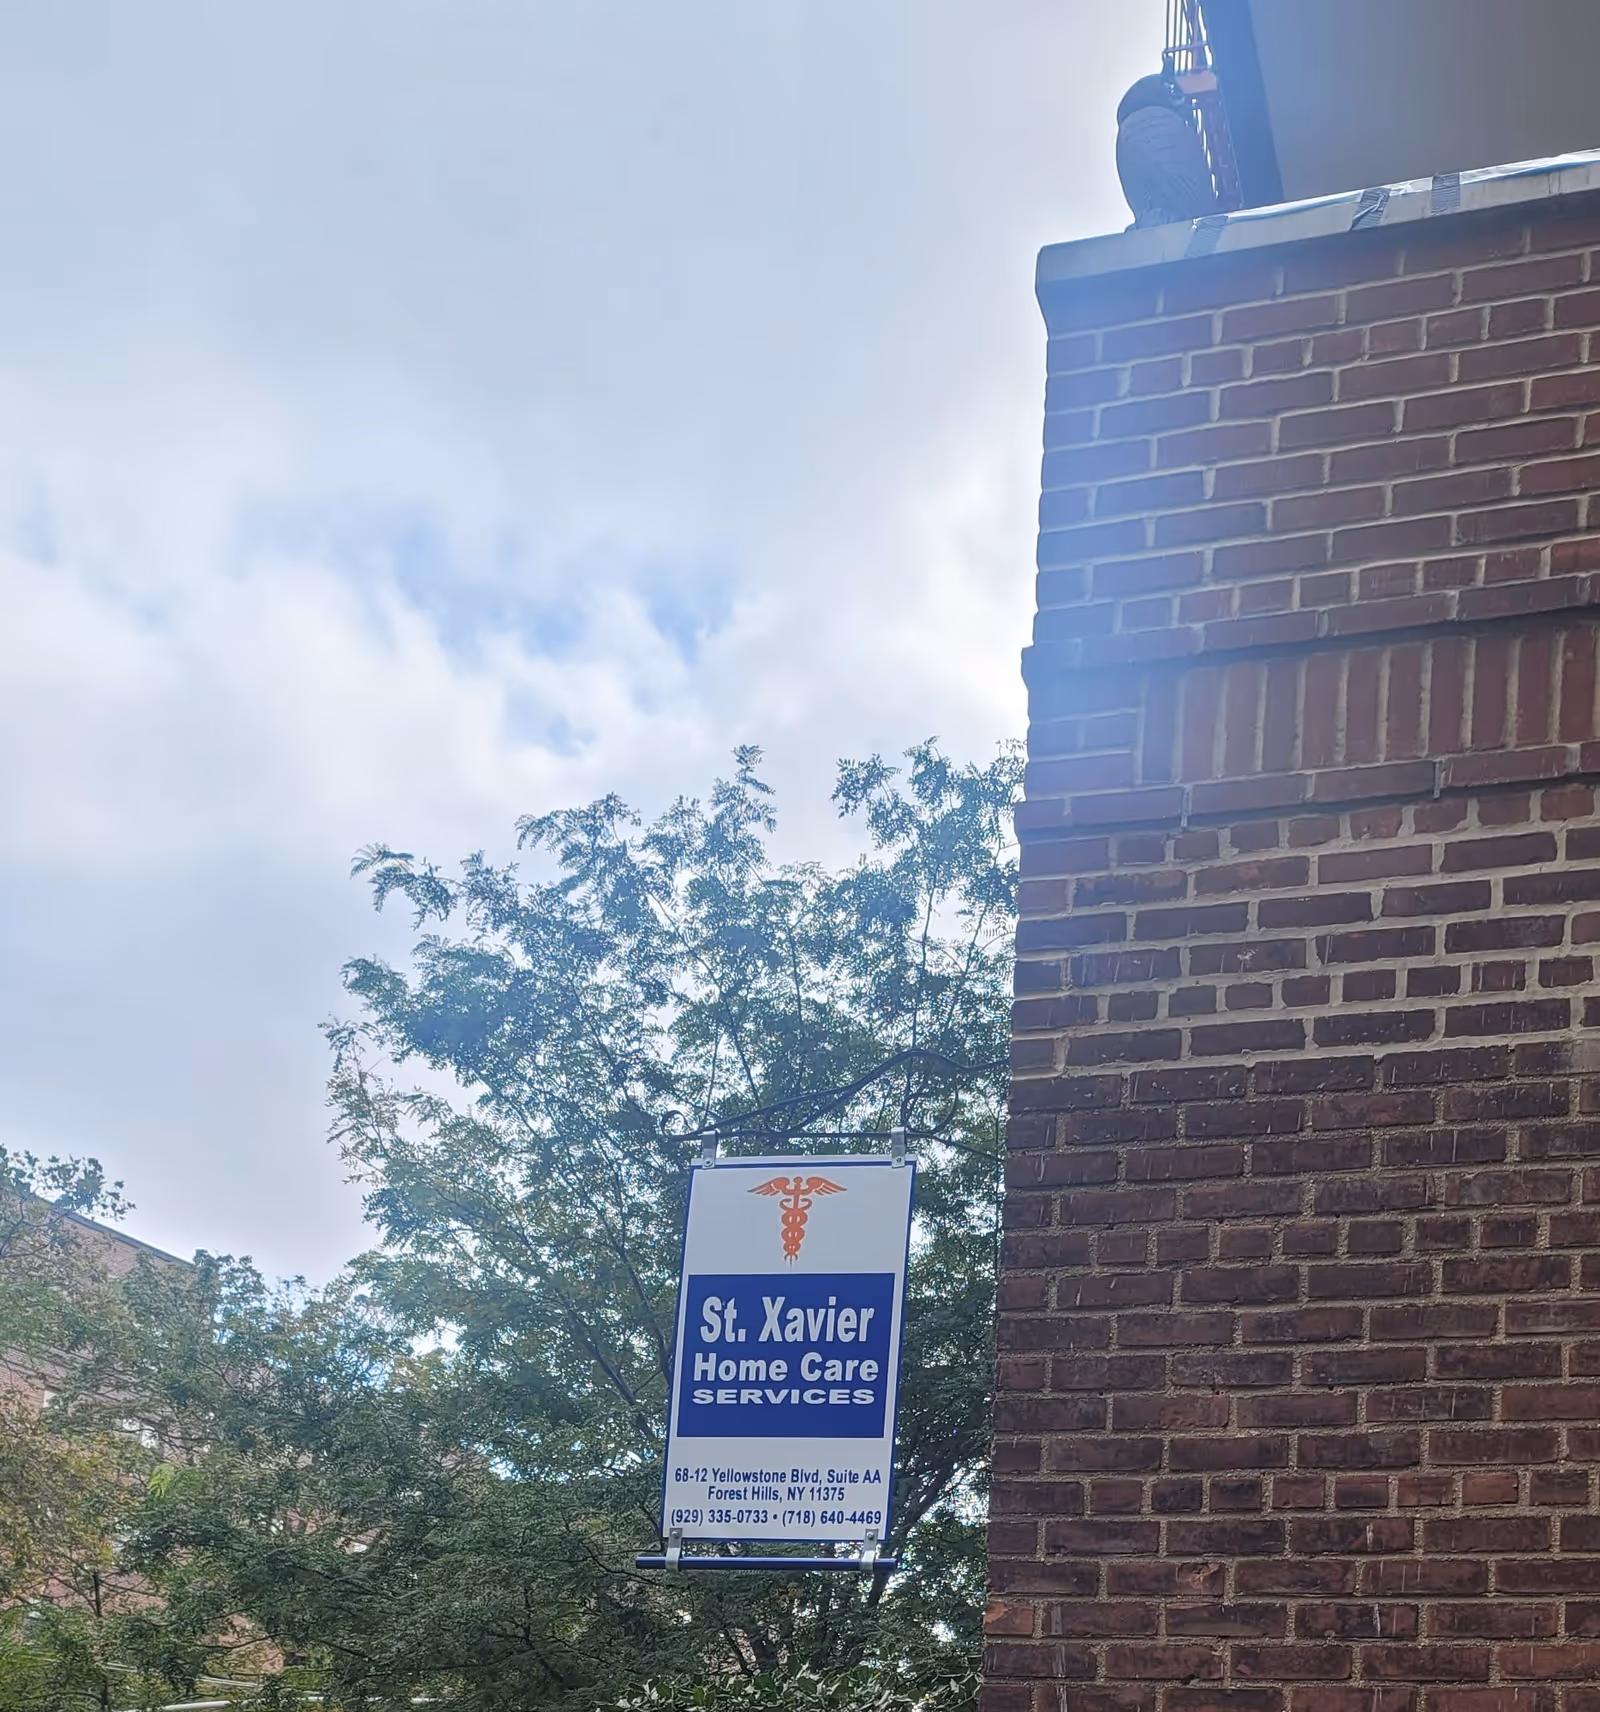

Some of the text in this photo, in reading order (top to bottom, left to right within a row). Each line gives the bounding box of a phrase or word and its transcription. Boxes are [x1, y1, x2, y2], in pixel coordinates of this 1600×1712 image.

[700, 1296, 875, 1343] St. Xavier
[693, 1352, 879, 1382] Home Care
[692, 1389, 875, 1405] SERVICES
[674, 1467, 881, 1486] 68-12 Yellowstone Blvd, Suite AA
[707, 1486, 845, 1503] Forest Hills, NY 11375
[671, 1509, 882, 1528] (929) 335-0733 (718) 640-4469
